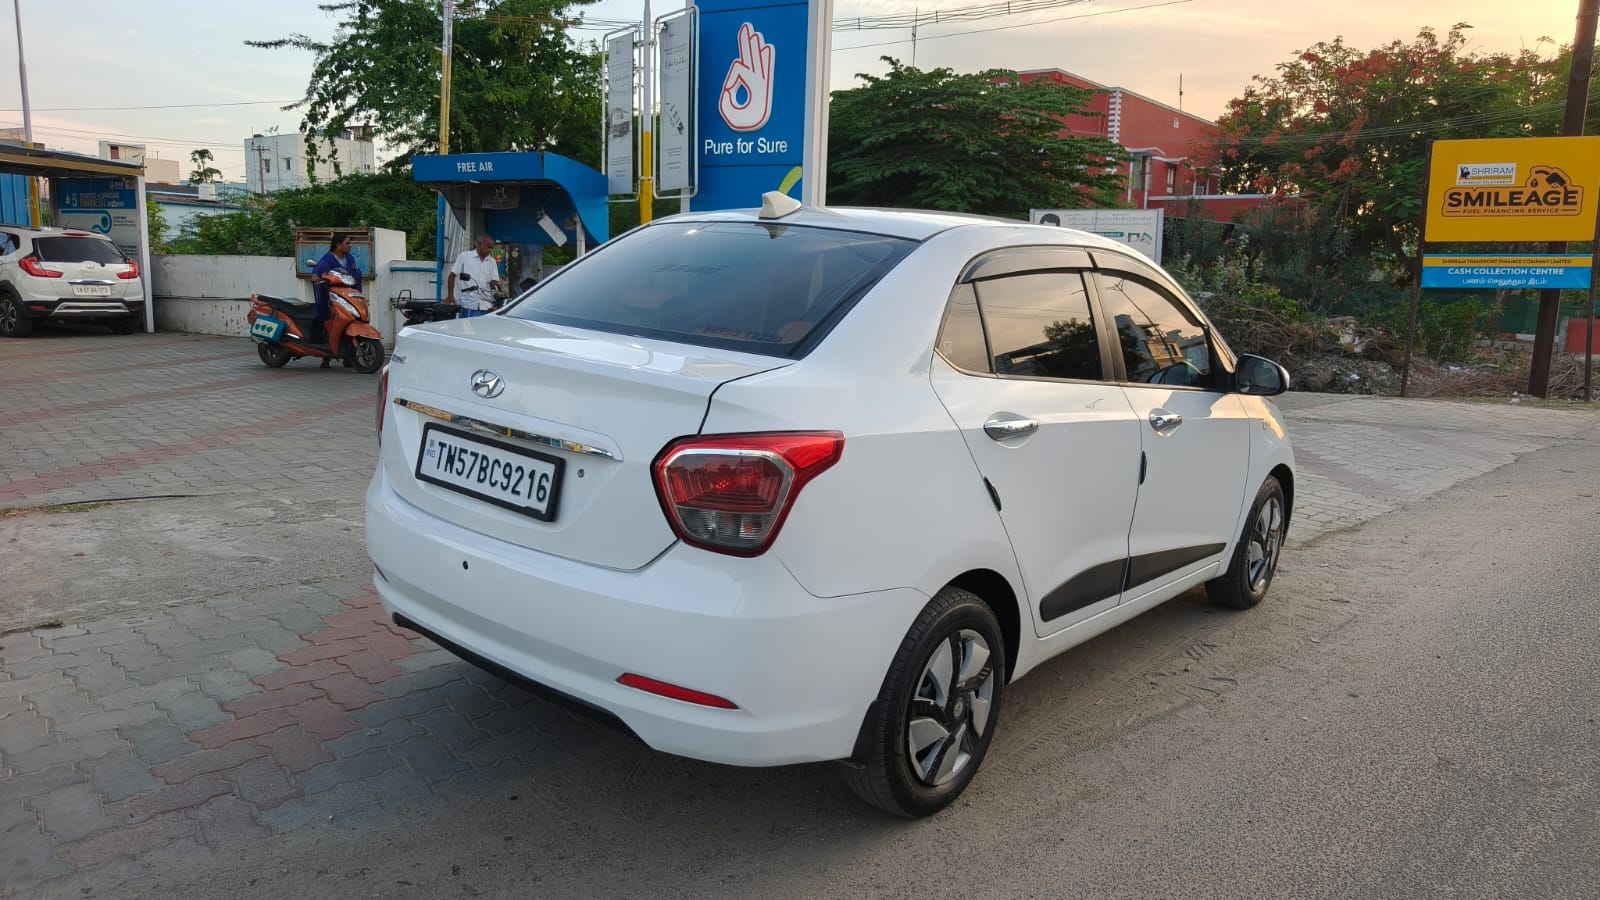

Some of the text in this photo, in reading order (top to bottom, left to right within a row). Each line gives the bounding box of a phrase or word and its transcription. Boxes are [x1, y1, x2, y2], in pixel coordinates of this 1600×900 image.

[705, 137, 788, 155] Pure for Sure
[456, 161, 494, 173] FREE AIR
[1471, 167, 1514, 176] SHRIRAM
[1447, 190, 1579, 208] SMILEAGE
[437, 441, 550, 502] TN57BC9216
